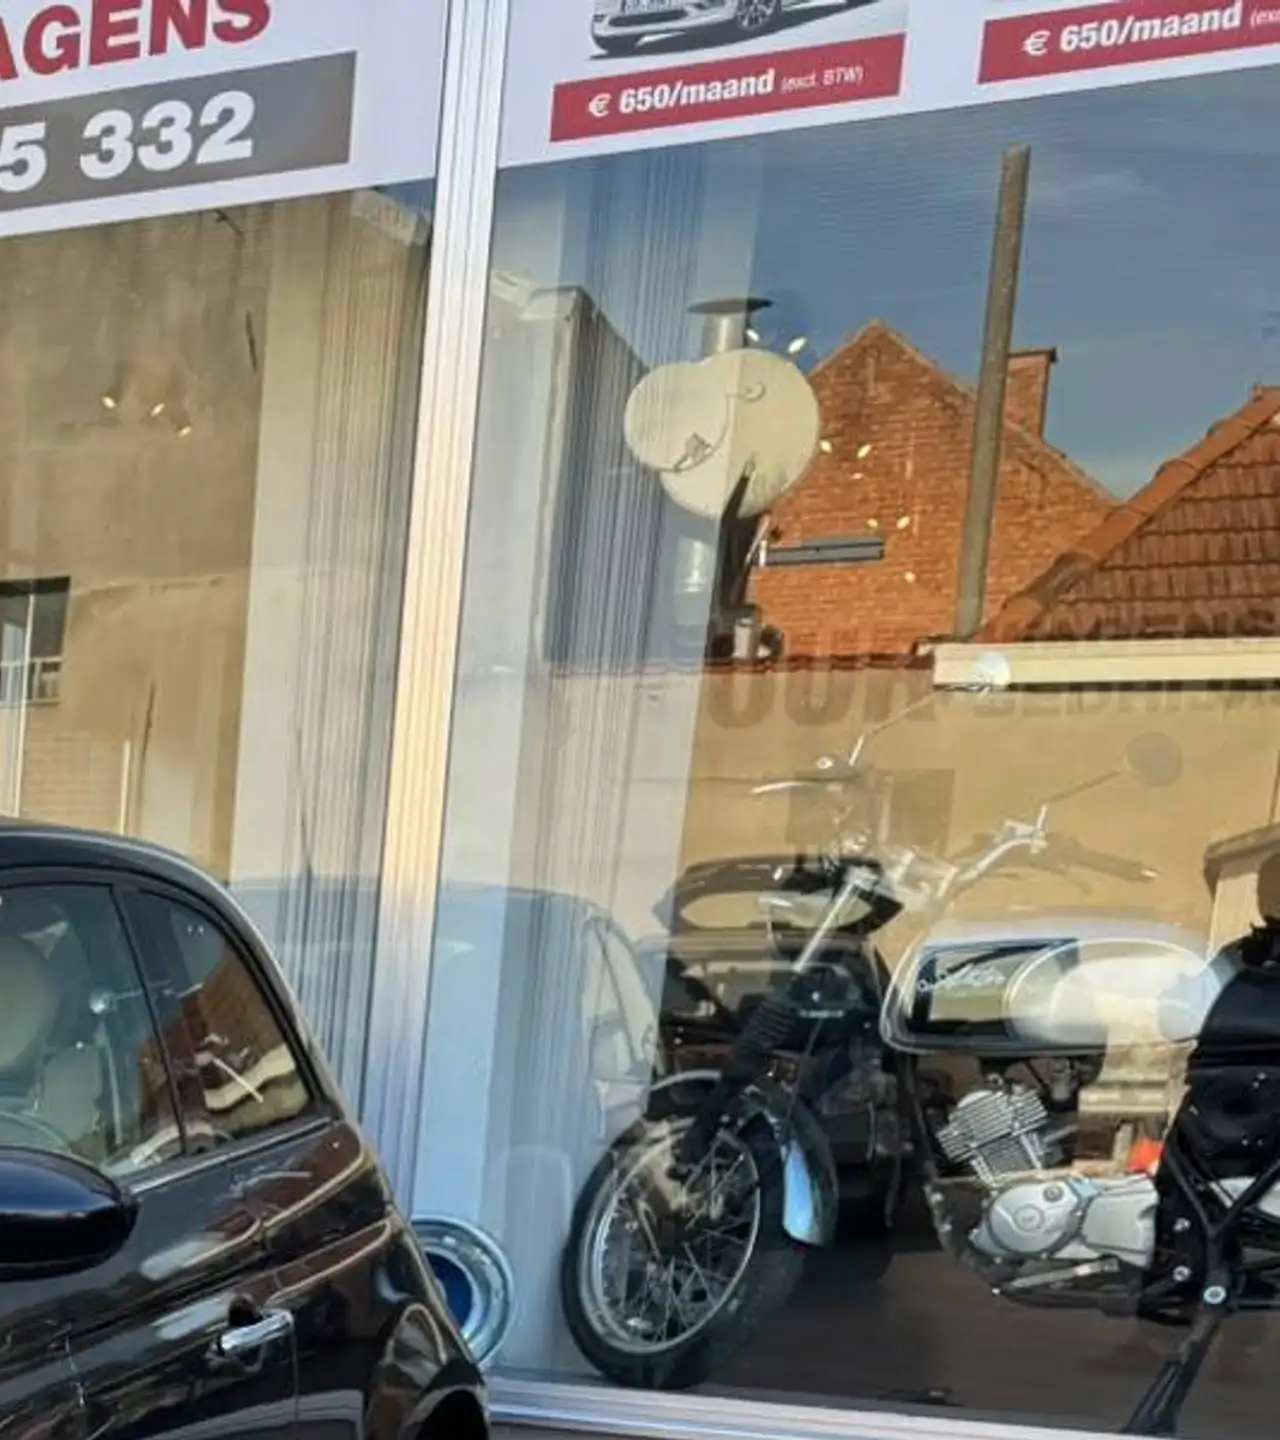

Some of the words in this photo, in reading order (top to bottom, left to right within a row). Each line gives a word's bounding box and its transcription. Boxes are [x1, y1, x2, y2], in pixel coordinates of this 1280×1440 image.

[1021, 29, 1051, 57] €
[1059, 0, 1243, 53] 650/maand
[588, 92, 612, 118] €
[618, 67, 776, 115] 650/maand
[78, 89, 255, 180] 332
